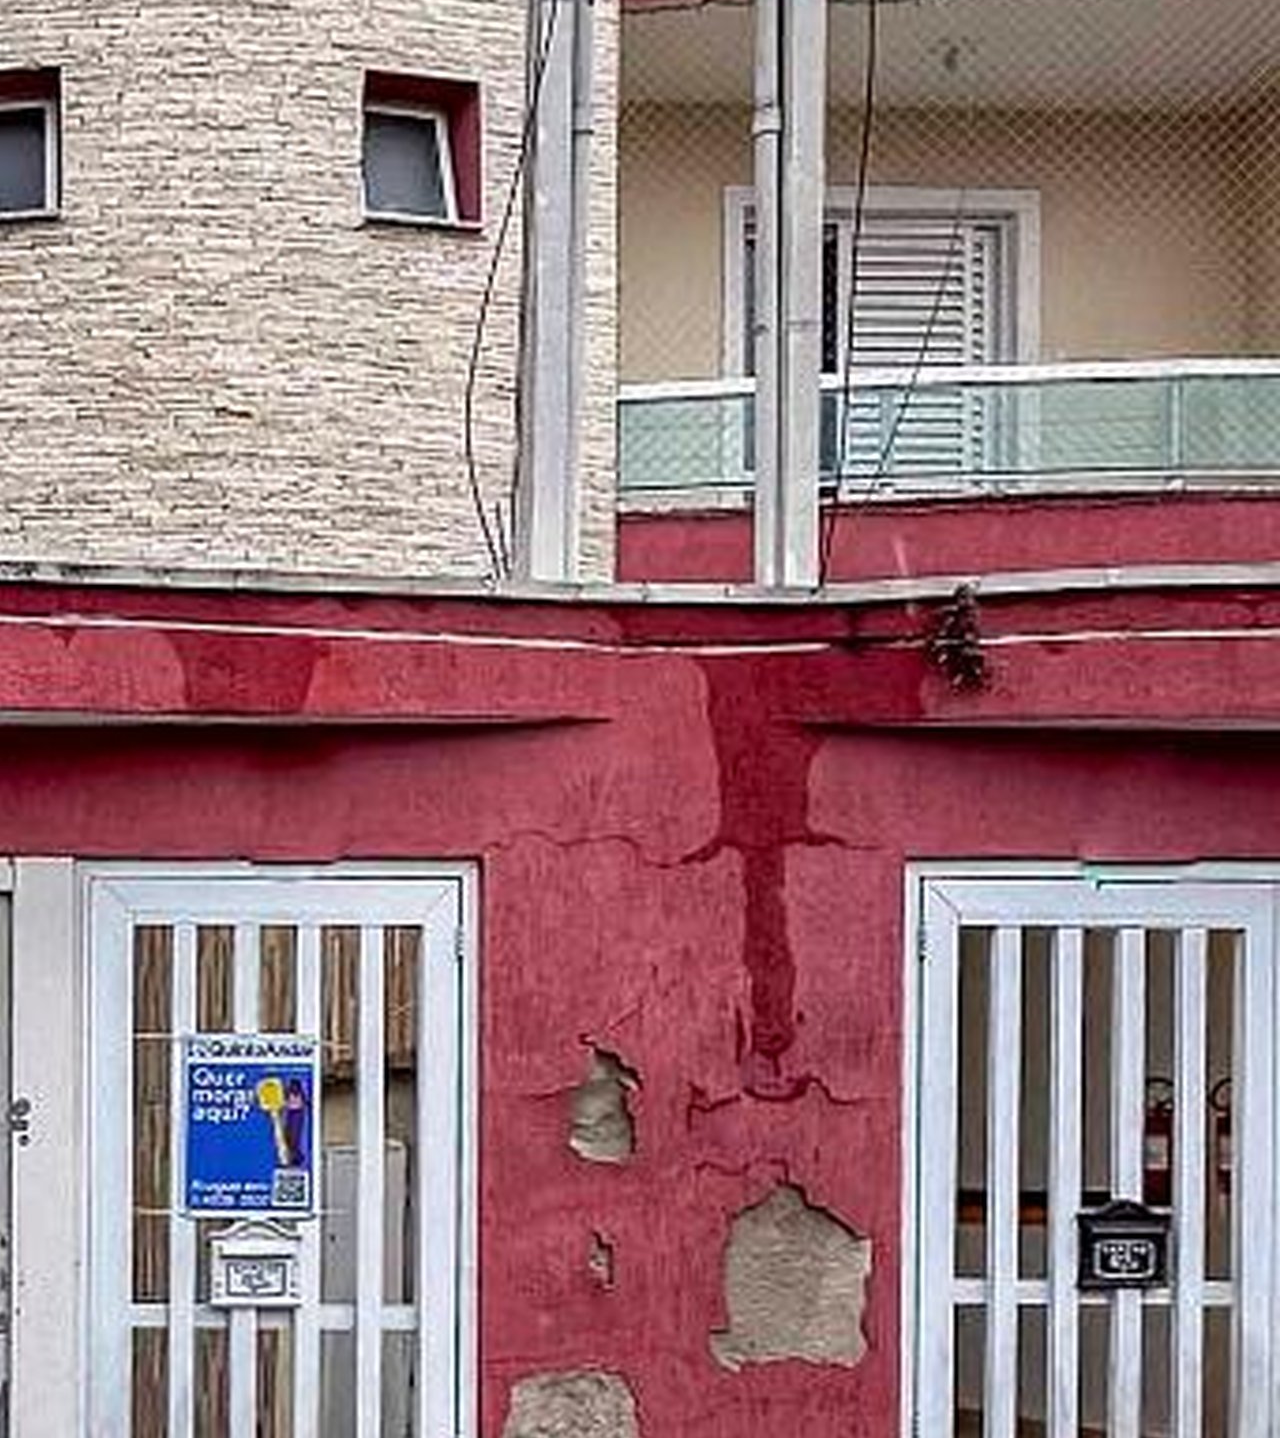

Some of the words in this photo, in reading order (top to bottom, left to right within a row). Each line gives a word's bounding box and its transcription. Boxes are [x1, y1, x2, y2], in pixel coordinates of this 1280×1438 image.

[192, 1067, 246, 1087] Quer
[192, 1089, 254, 1103] morar
[192, 1104, 251, 1124] aqui?
